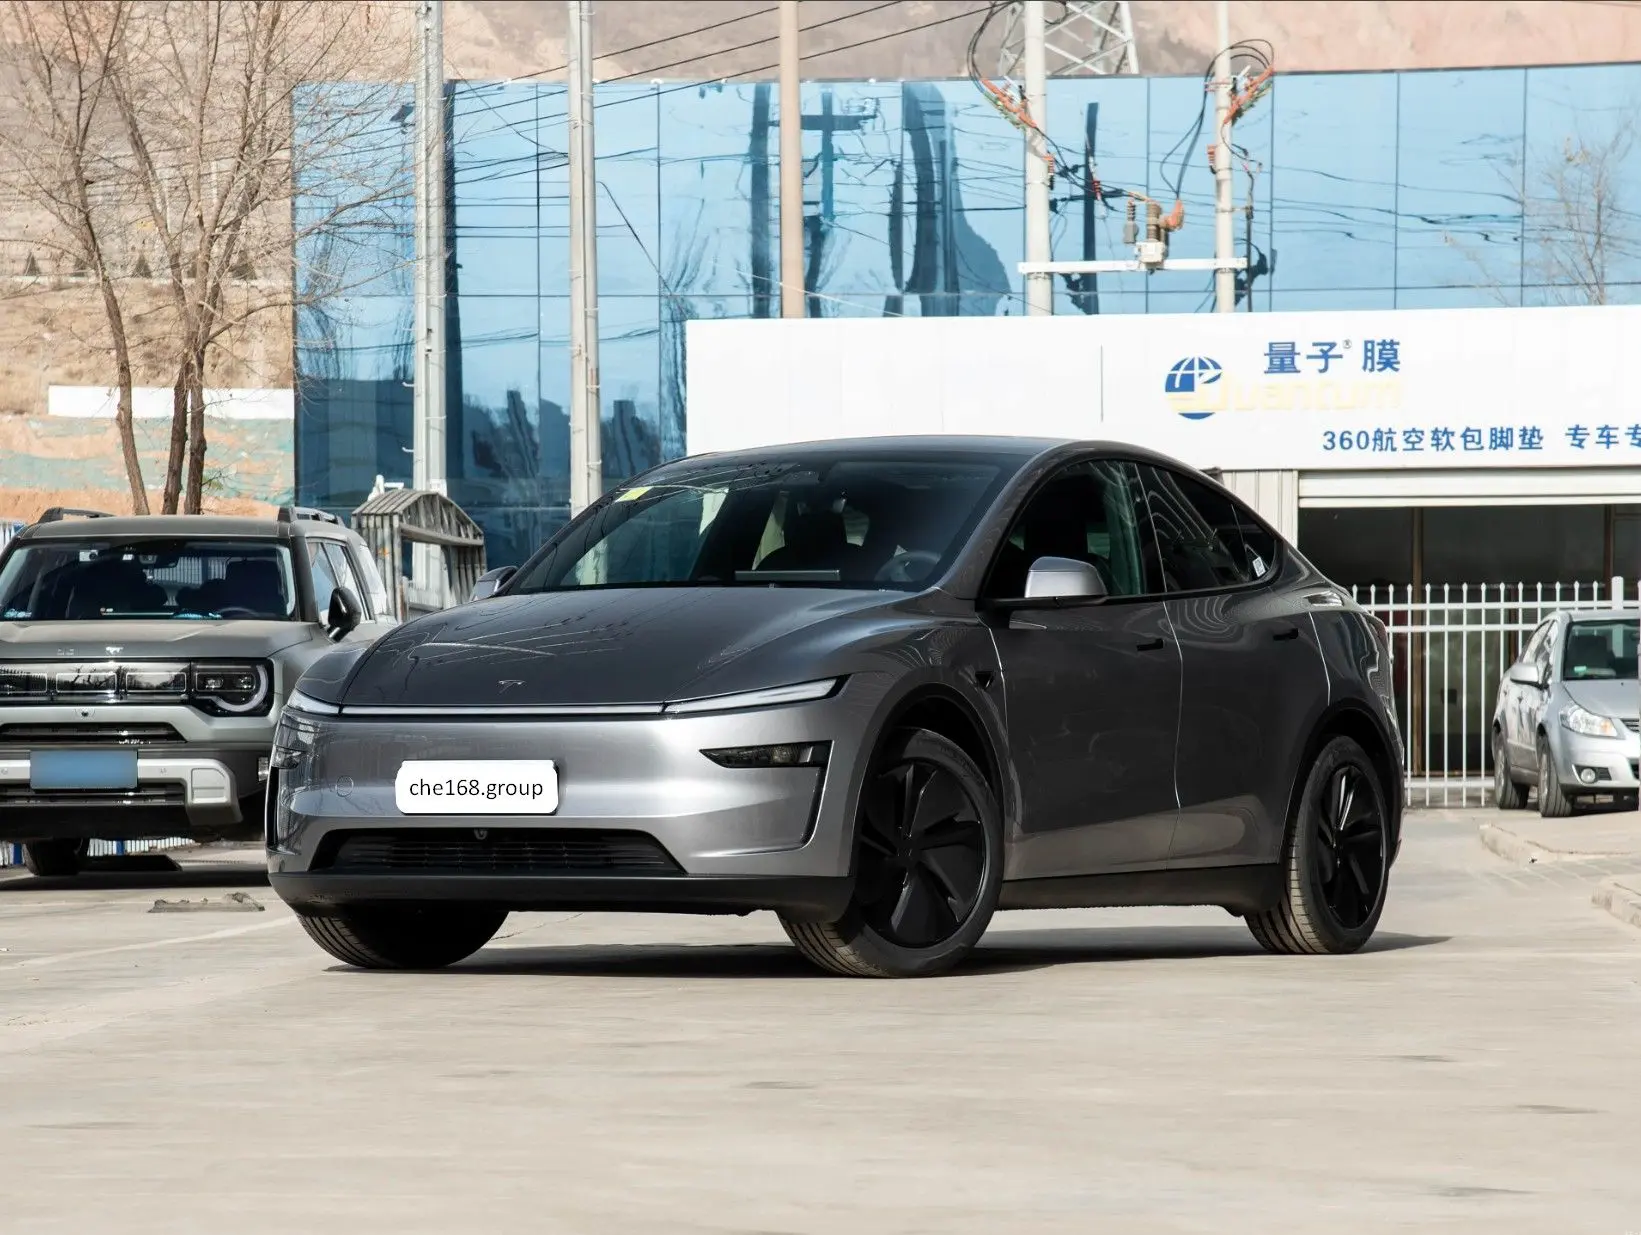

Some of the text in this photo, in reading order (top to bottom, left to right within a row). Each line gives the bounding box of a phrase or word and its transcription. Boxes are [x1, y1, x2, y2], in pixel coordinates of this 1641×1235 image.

[1322, 425, 1544, 453] 360航空软包脚垫
